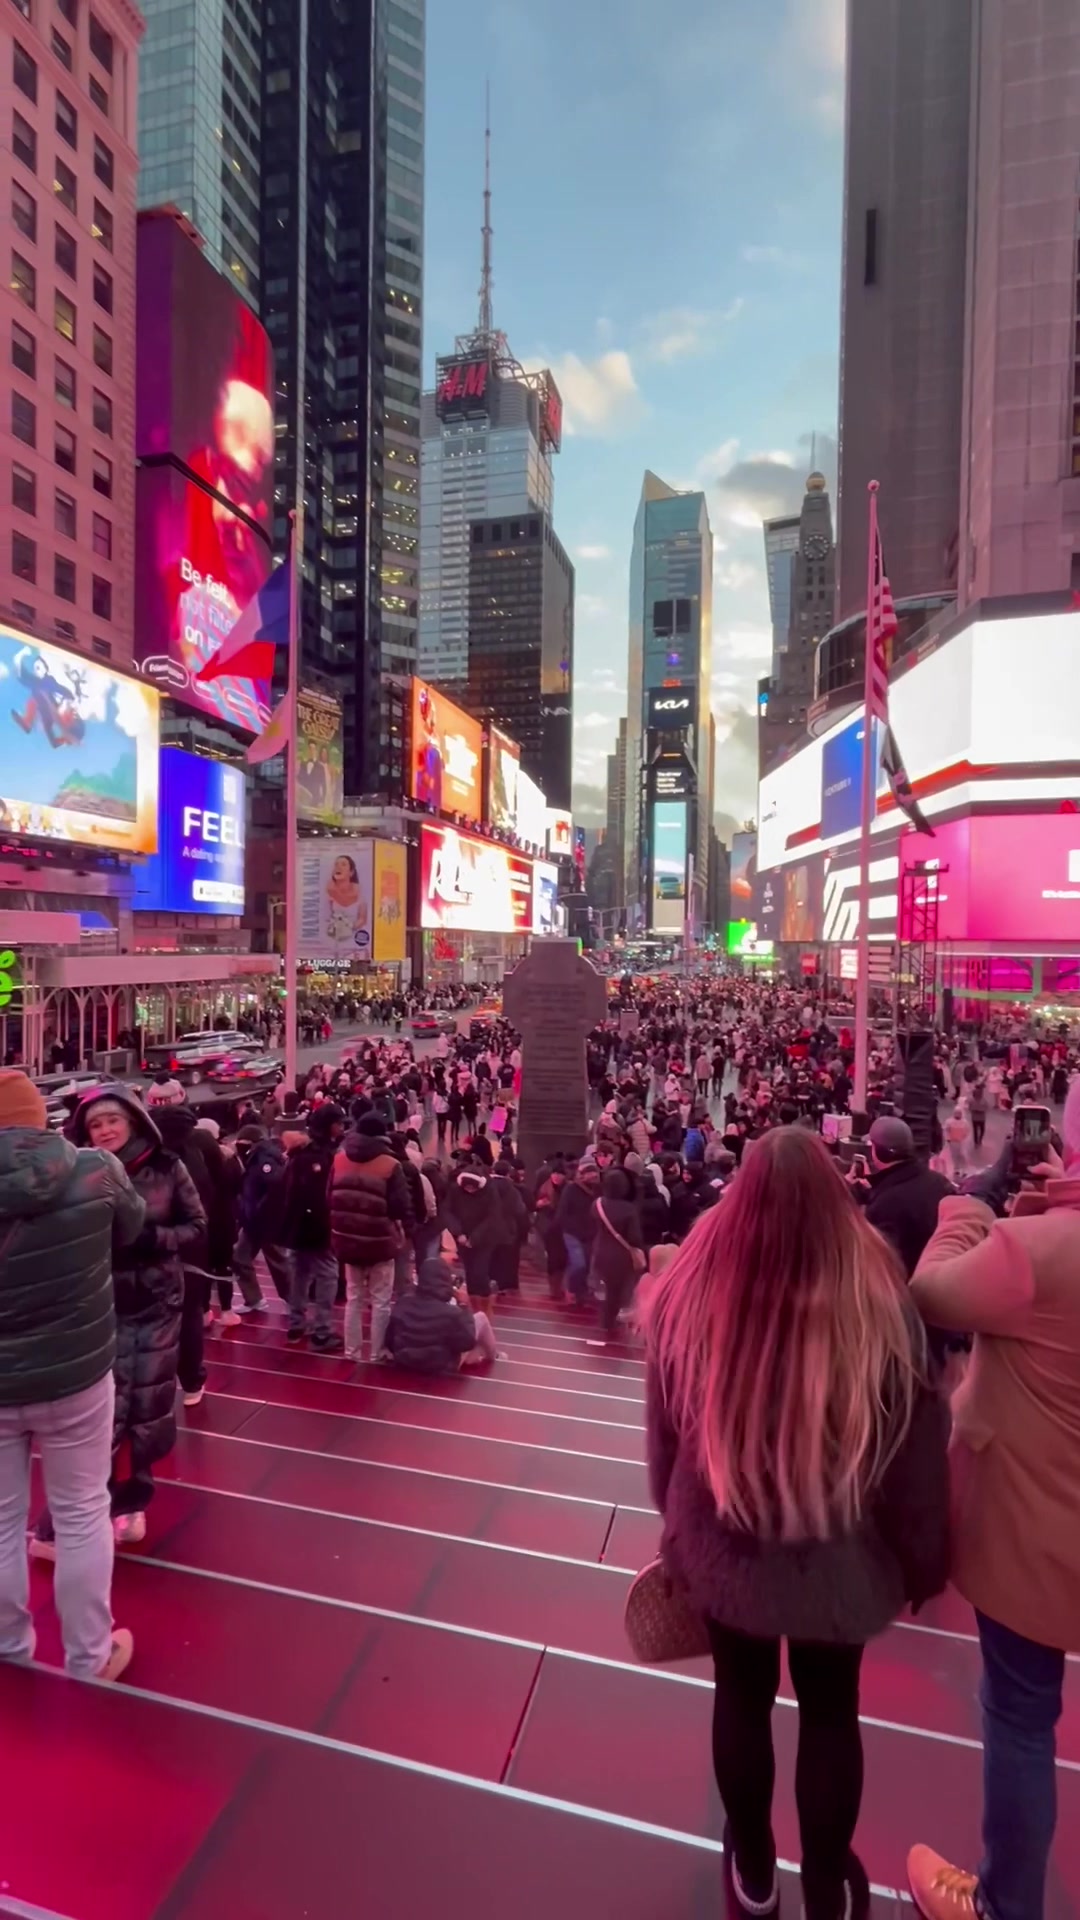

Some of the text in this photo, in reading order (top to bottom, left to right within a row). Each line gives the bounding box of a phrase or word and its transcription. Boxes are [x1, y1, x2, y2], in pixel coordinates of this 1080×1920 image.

[438, 361, 489, 402] H&M
[181, 557, 202, 589] Be
[185, 625, 204, 650] on
[297, 703, 340, 731] THE GREAT
[654, 699, 690, 710] KIA
[302, 890, 320, 938] MAMMA
